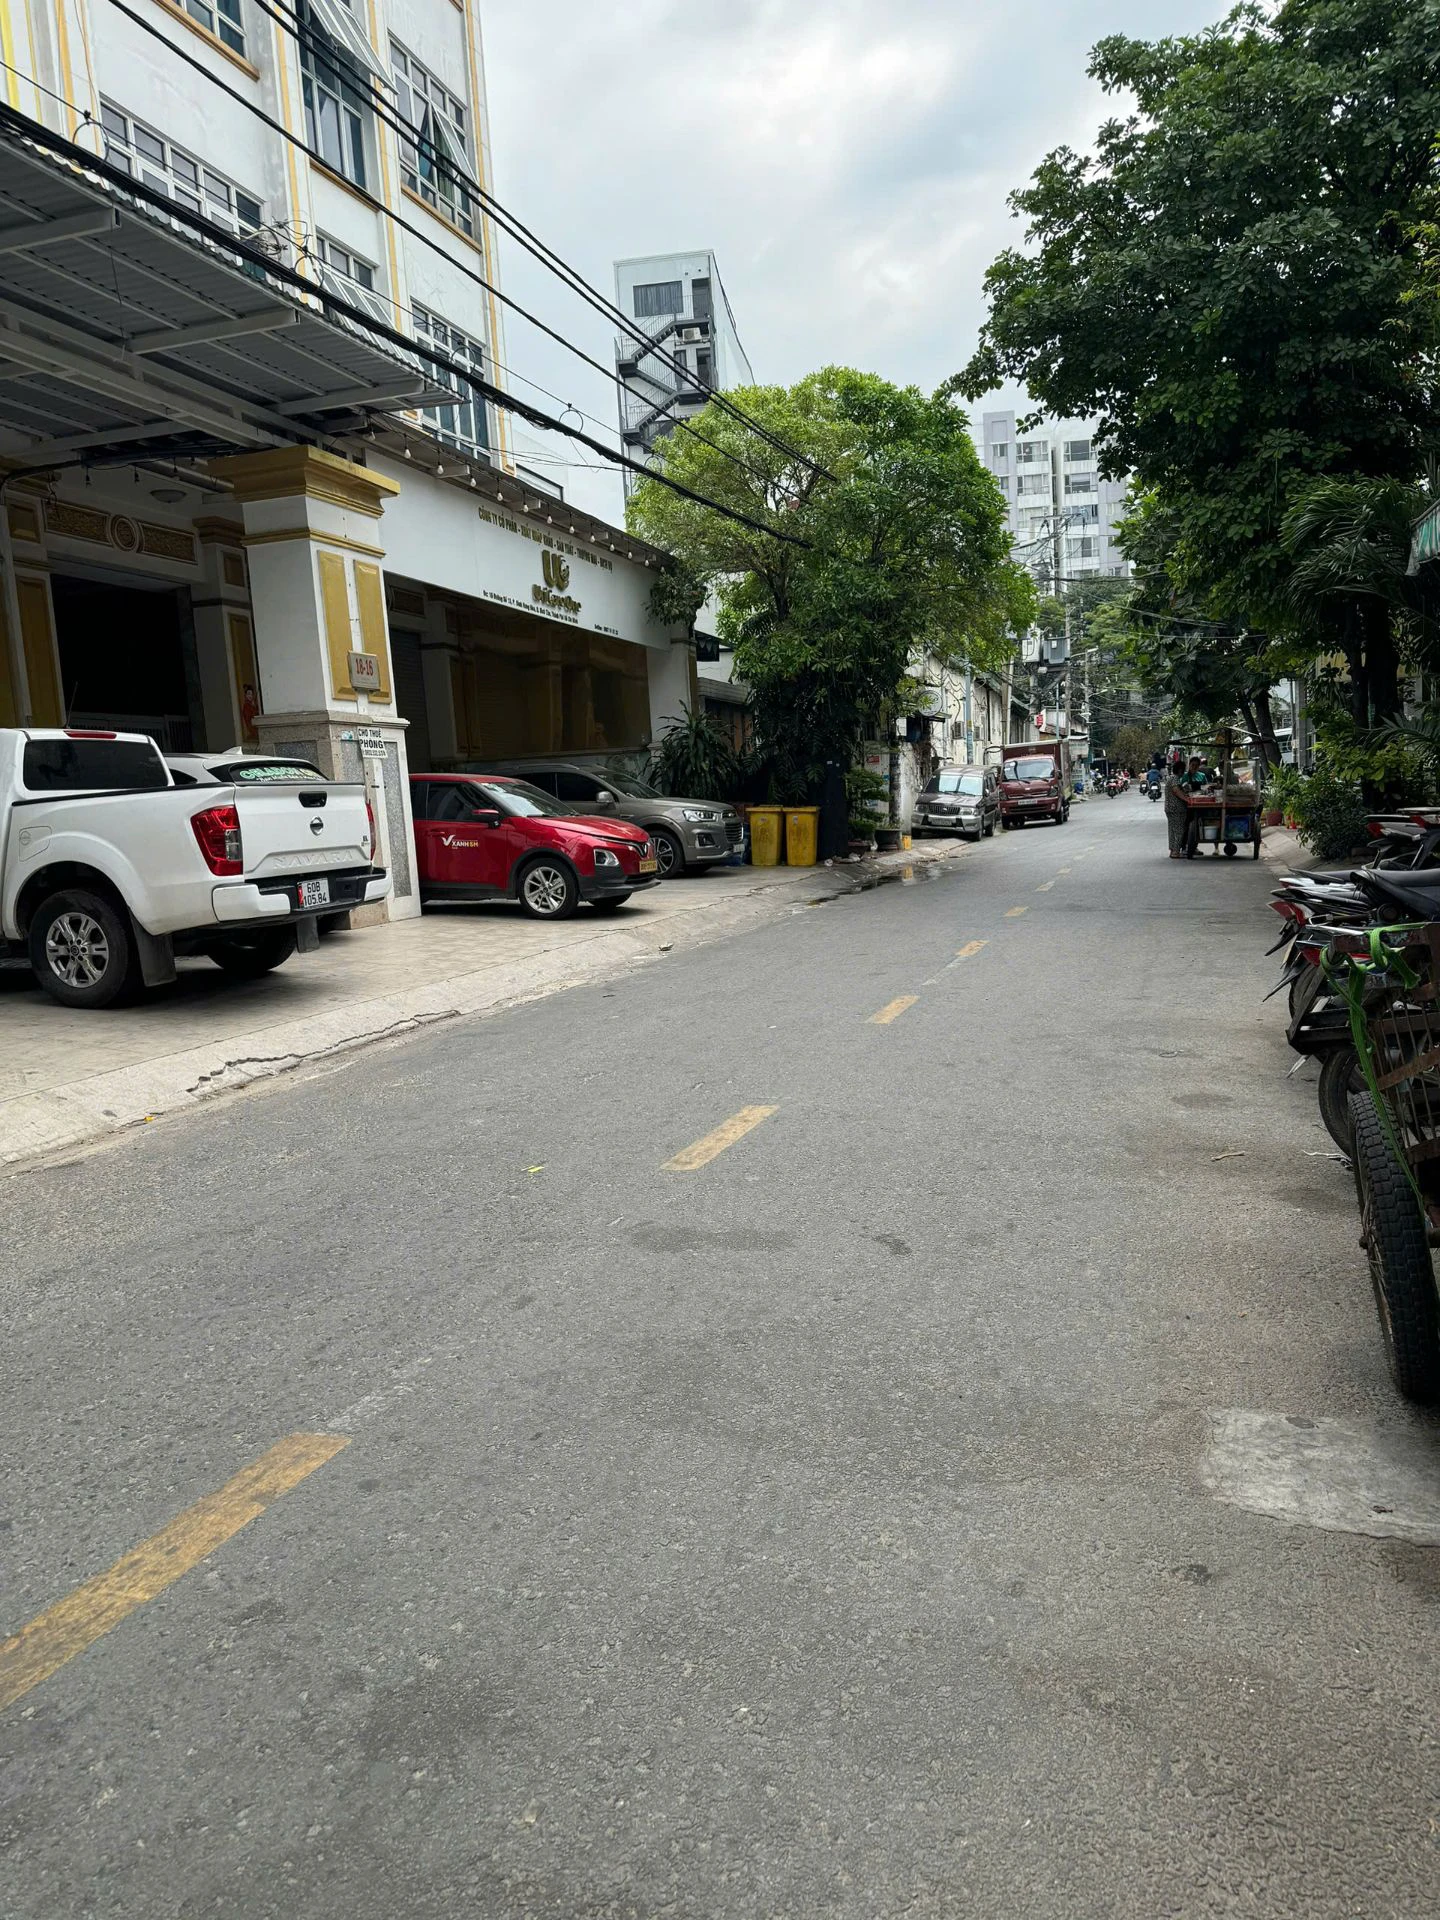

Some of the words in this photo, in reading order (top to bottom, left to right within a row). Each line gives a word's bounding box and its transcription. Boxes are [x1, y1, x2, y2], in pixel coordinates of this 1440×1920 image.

[358, 728, 368, 737] CHO
[273, 850, 352, 869] NAVARA
[304, 892, 326, 906] 105.84
